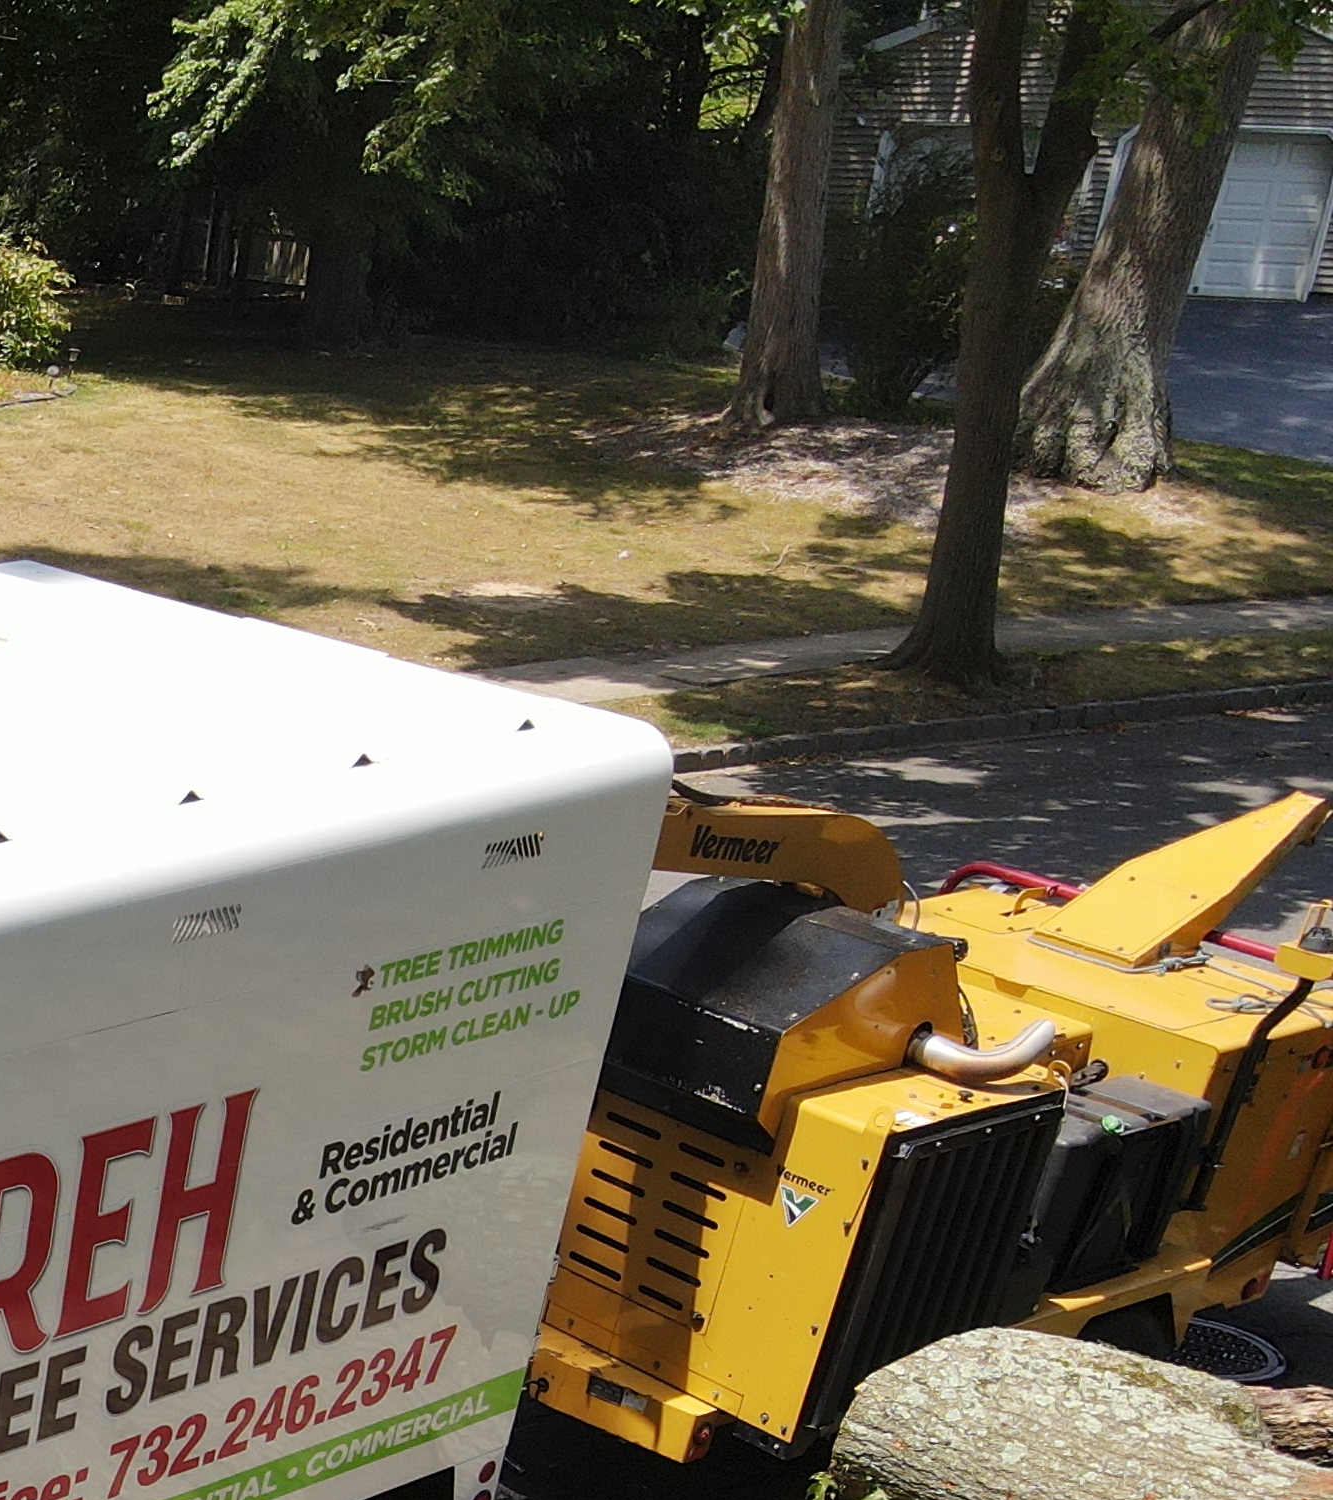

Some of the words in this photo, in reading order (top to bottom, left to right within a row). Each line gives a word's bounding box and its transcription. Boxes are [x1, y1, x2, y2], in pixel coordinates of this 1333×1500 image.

[689, 824, 780, 865] Vermeer
[368, 985, 454, 1032] BRUSH
[457, 958, 561, 1006] CUTTING
[379, 950, 443, 990] TREE
[448, 918, 564, 971] TRIMMING
[359, 1025, 449, 1072] STORM
[451, 1002, 532, 1046] CLEAN
[548, 990, 581, 1020] UP
[290, 1188, 316, 1226] &
[324, 1121, 519, 1214] Commercial
[319, 1090, 502, 1180] Residential
[776, 1164, 832, 1197] Vermeer
[103, 1227, 448, 1418] SERVICES
[106, 1326, 458, 1500] 732.246.2347
[304, 1390, 492, 1478] COMMERCIAL
